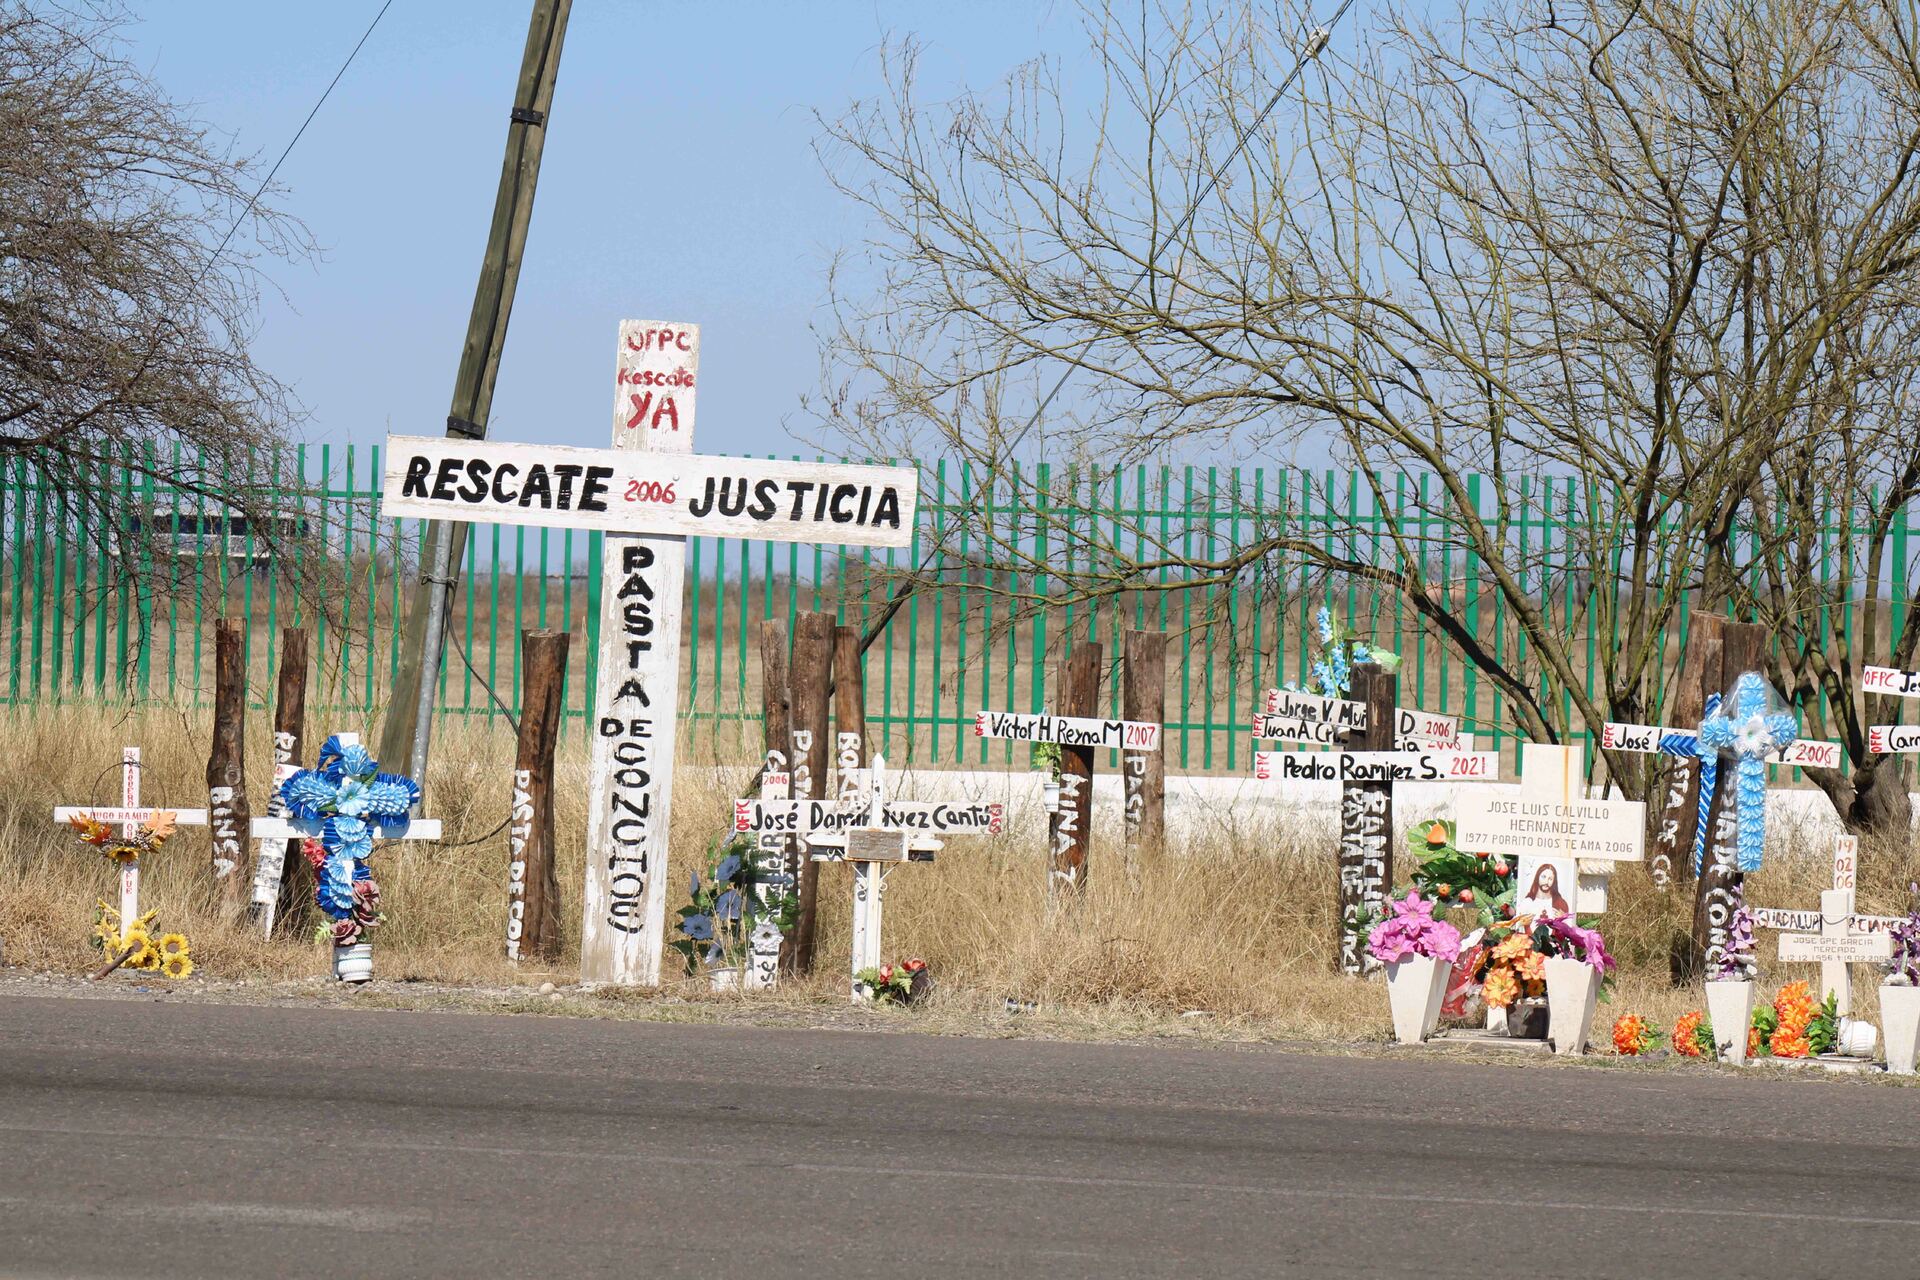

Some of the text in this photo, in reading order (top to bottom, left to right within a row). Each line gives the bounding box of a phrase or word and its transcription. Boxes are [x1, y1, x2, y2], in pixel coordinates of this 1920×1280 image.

[627, 390, 679, 431] YA
[401, 455, 900, 530] RESCATE 2006 JUSTICIA
[617, 545, 655, 708] PASTA
[1863, 669, 1896, 688] OFPC
[599, 717, 653, 738] DE
[1057, 719, 1100, 745] Reyna
[1126, 725, 1156, 747] 2007
[1260, 716, 1296, 738] Juan
[1297, 719, 1313, 740] A.
[1322, 700, 1334, 722] V.
[1399, 711, 1419, 735] D.
[1425, 720, 1450, 738] 2006
[1614, 726, 1652, 750] José
[1795, 743, 1834, 766] 2006
[1870, 726, 1882, 753] OFPC
[1256, 752, 1270, 780] OFPC
[1283, 754, 1336, 780] Pedro
[1420, 756, 1446, 780] S.
[1450, 756, 1487, 776] 2021
[1666, 755, 1690, 809] ASTA
[512, 770, 534, 855] PASTA
[736, 800, 751, 831] OFPC
[750, 802, 799, 831] José
[932, 804, 991, 830] Cantú
[1058, 773, 1088, 855] MINA
[1487, 801, 1609, 820] JOSE LUIS CALVILLO
[1510, 819, 1586, 836] HERNANDEZ
[1465, 833, 1633, 853] 1977 PORRITO DIOS TE AMA 2006
[509, 861, 525, 895] DE
[1836, 857, 1853, 872] 02
[1836, 874, 1853, 889] 06
[1757, 909, 1823, 931] GUADALUP
